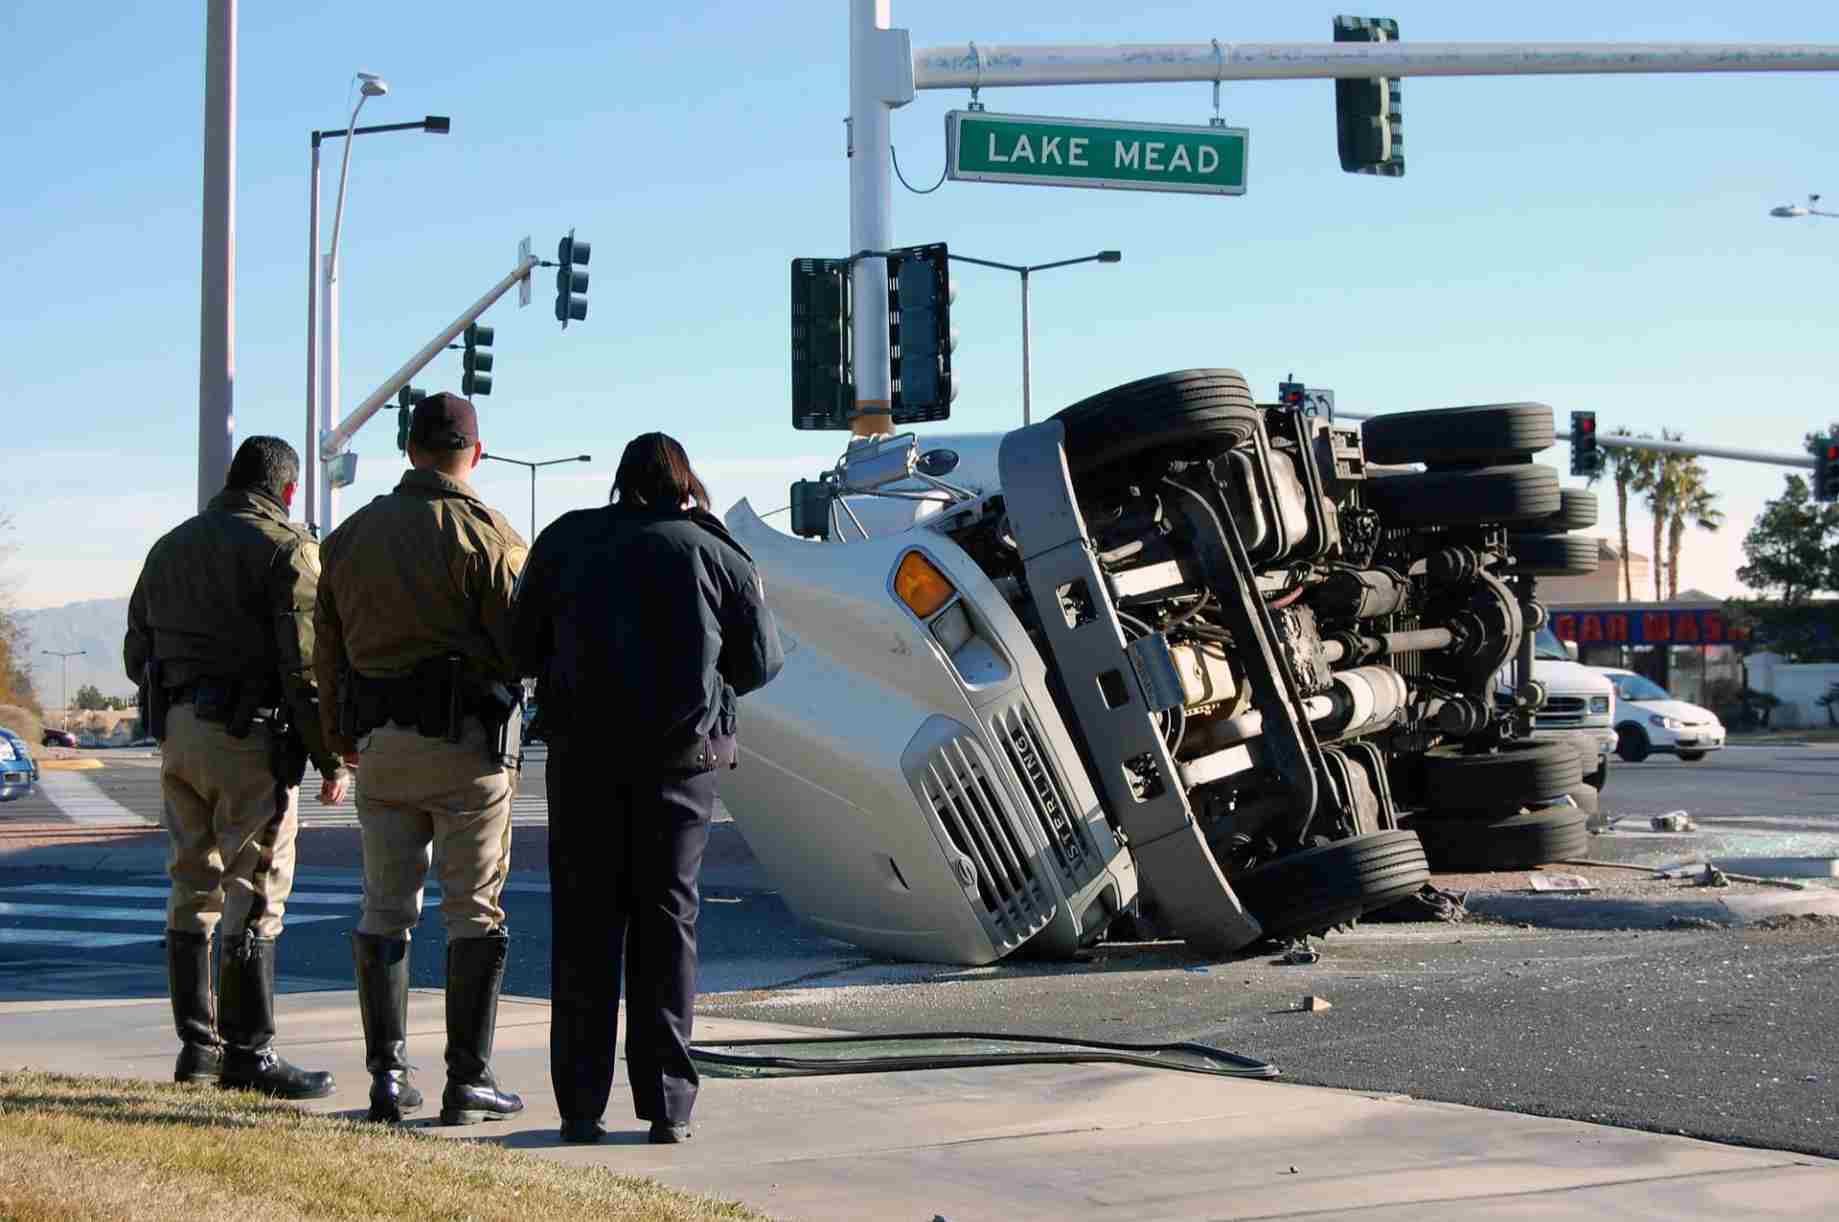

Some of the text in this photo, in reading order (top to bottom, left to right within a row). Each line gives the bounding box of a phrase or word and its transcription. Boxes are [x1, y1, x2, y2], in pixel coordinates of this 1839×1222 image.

[988, 132, 1219, 174] LAKE MEAD
[1555, 614, 1629, 642] CAR
[1014, 736, 1080, 859] STERLING
